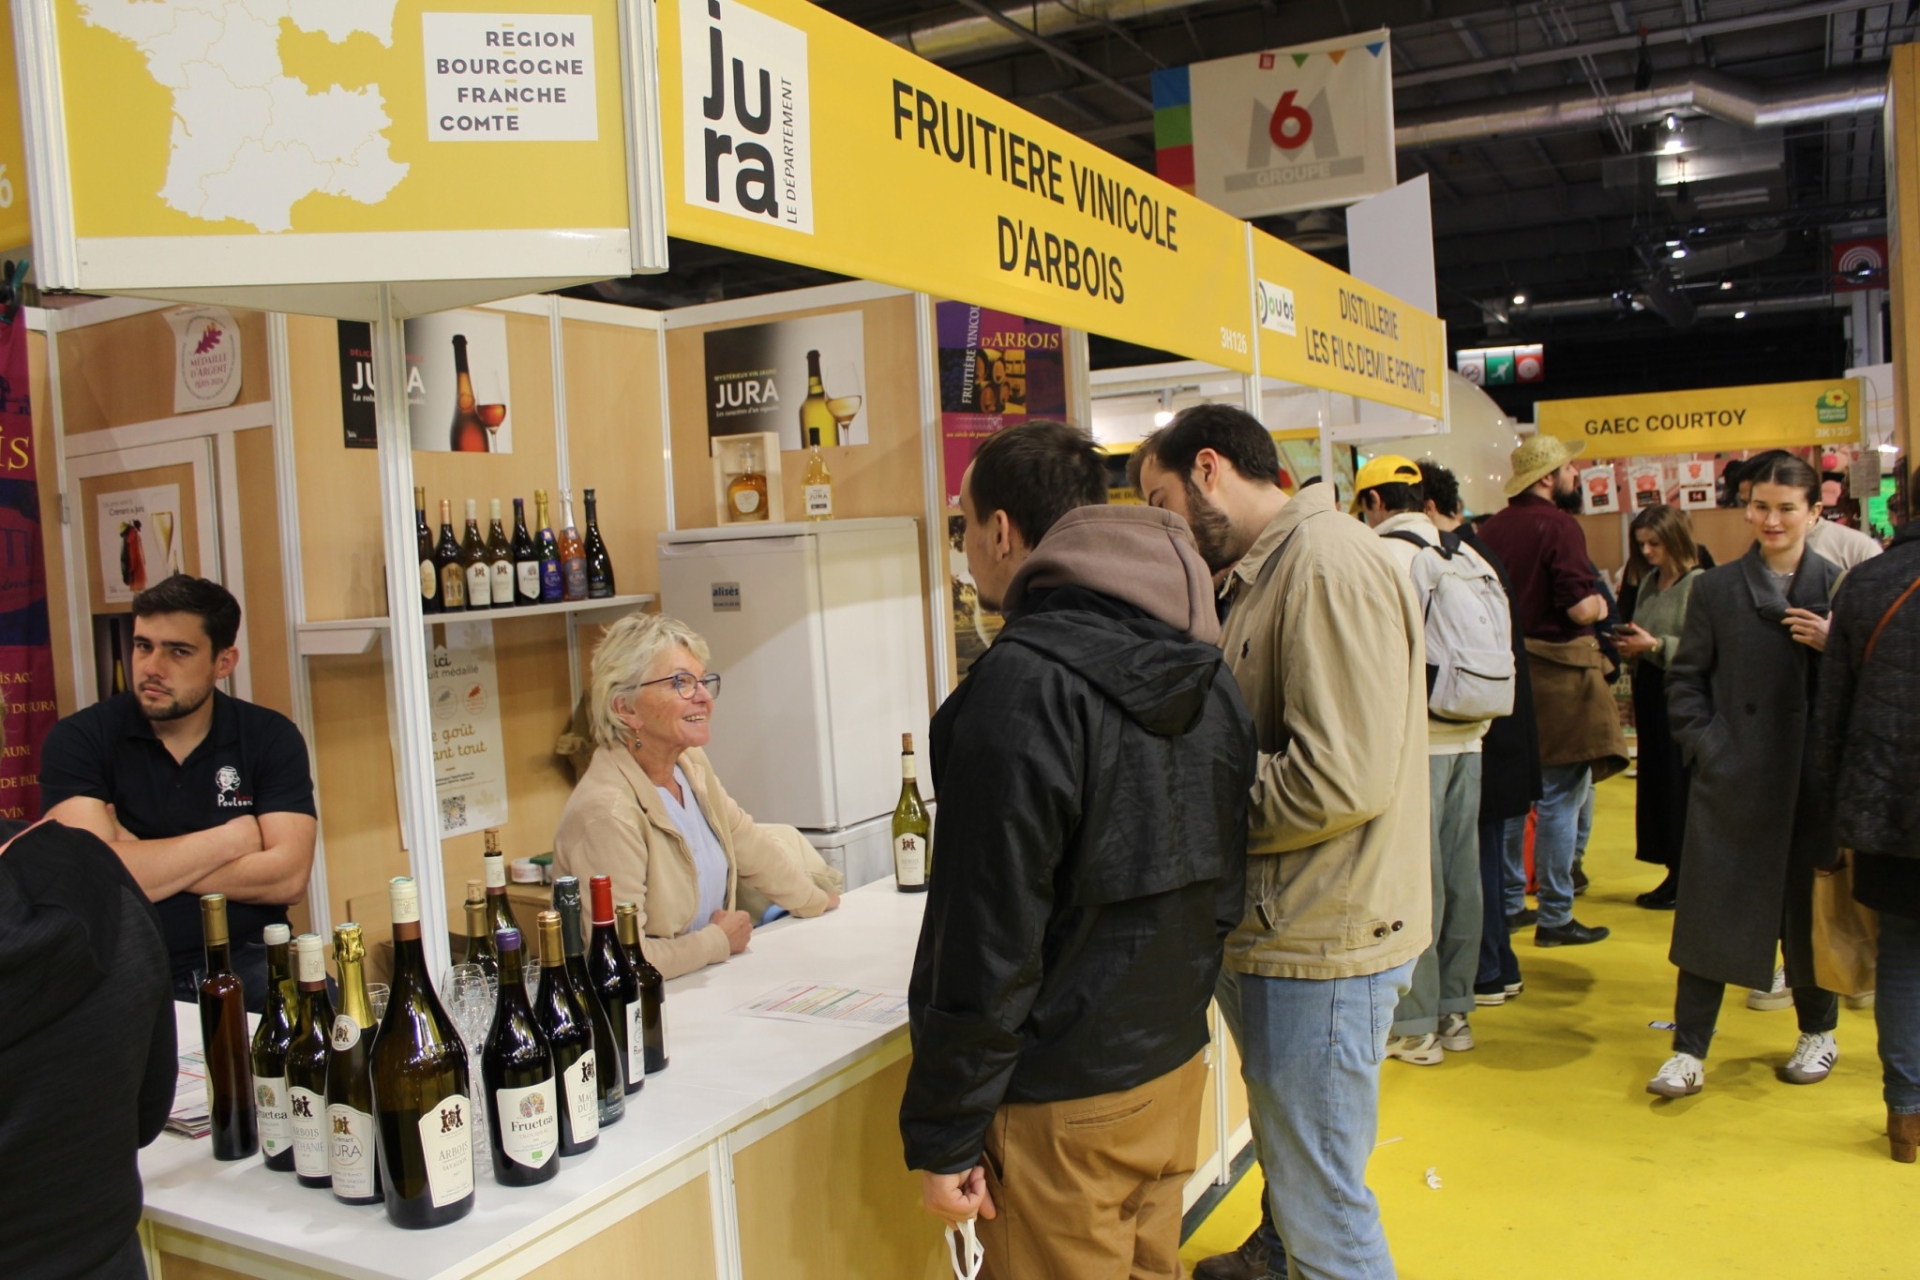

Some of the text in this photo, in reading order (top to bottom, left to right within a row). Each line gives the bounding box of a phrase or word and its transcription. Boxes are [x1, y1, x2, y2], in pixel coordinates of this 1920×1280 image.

[436, 58, 584, 75] BOURGOGNE
[457, 87, 567, 103] FRANCHE
[780, 76, 798, 224] LE DÉPARTEMENT
[704, 127, 779, 219] ra
[892, 77, 1179, 253] FRUITIERE VINICOLE
[1256, 163, 1333, 187] GROUPE
[997, 214, 1125, 305] D'ARBOIS
[1339, 288, 1399, 341] DISTILLERIE
[1219, 326, 1248, 355] 3H126
[1304, 326, 1330, 365] LES
[1331, 335, 1356, 374] FILS
[715, 378, 780, 409] JURA
[1584, 408, 1747, 436] GAEC COURTOY
[433, 653, 452, 668] ici
[442, 723, 475, 745] goût
[457, 741, 488, 757] tout
[510, 1115, 554, 1132] Fructea
[438, 1140, 469, 1161] ARBOIS
